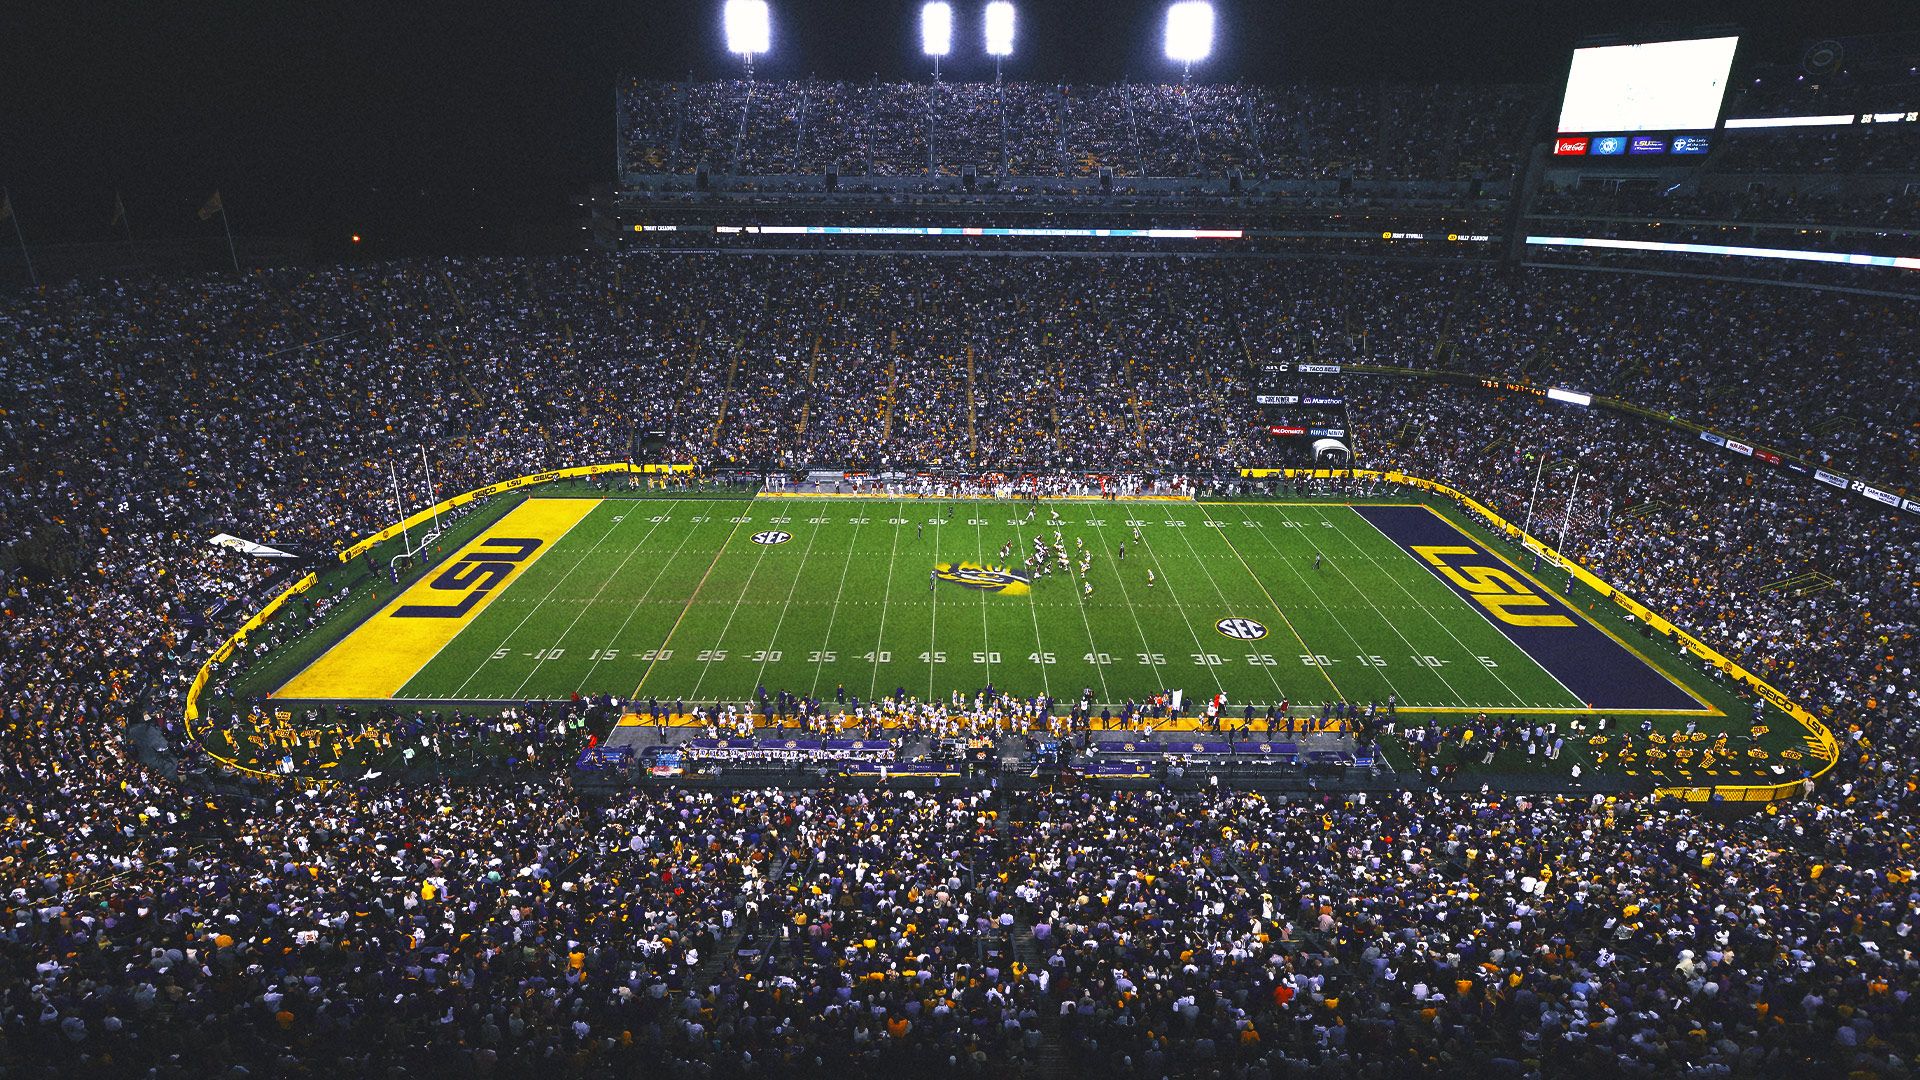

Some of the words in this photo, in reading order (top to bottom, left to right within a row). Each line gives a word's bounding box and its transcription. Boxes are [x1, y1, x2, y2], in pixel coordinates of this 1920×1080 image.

[1560, 142, 1586, 151] Coca-Cola
[506, 479, 522, 488] LSU
[1851, 480, 1865, 492] 22
[117, 501, 130, 512] 22
[753, 533, 791, 542] SEC
[390, 537, 543, 618] LSU
[1411, 546, 1578, 627] LSU
[1219, 620, 1264, 638] SEC
[493, 649, 509, 660] 5
[534, 649, 565, 661] 10
[589, 649, 620, 661] 15
[642, 649, 673, 661] 20
[697, 650, 728, 662] 25
[752, 650, 782, 663] 30
[808, 650, 836, 663] 35
[864, 651, 891, 663] 40
[919, 651, 946, 663] 45
[973, 651, 1001, 664] 50
[1028, 651, 1056, 664] 45
[1083, 652, 1111, 664] 40
[1137, 652, 1166, 665] 35
[1191, 653, 1222, 665] 30
[1245, 653, 1277, 666] 25
[1299, 654, 1332, 666] 20
[1355, 655, 1388, 667] 15
[1411, 655, 1442, 667] 10
[1478, 656, 1498, 668] 5
[1757, 684, 1794, 712] GEICO
[1806, 716, 1825, 736] LSU
